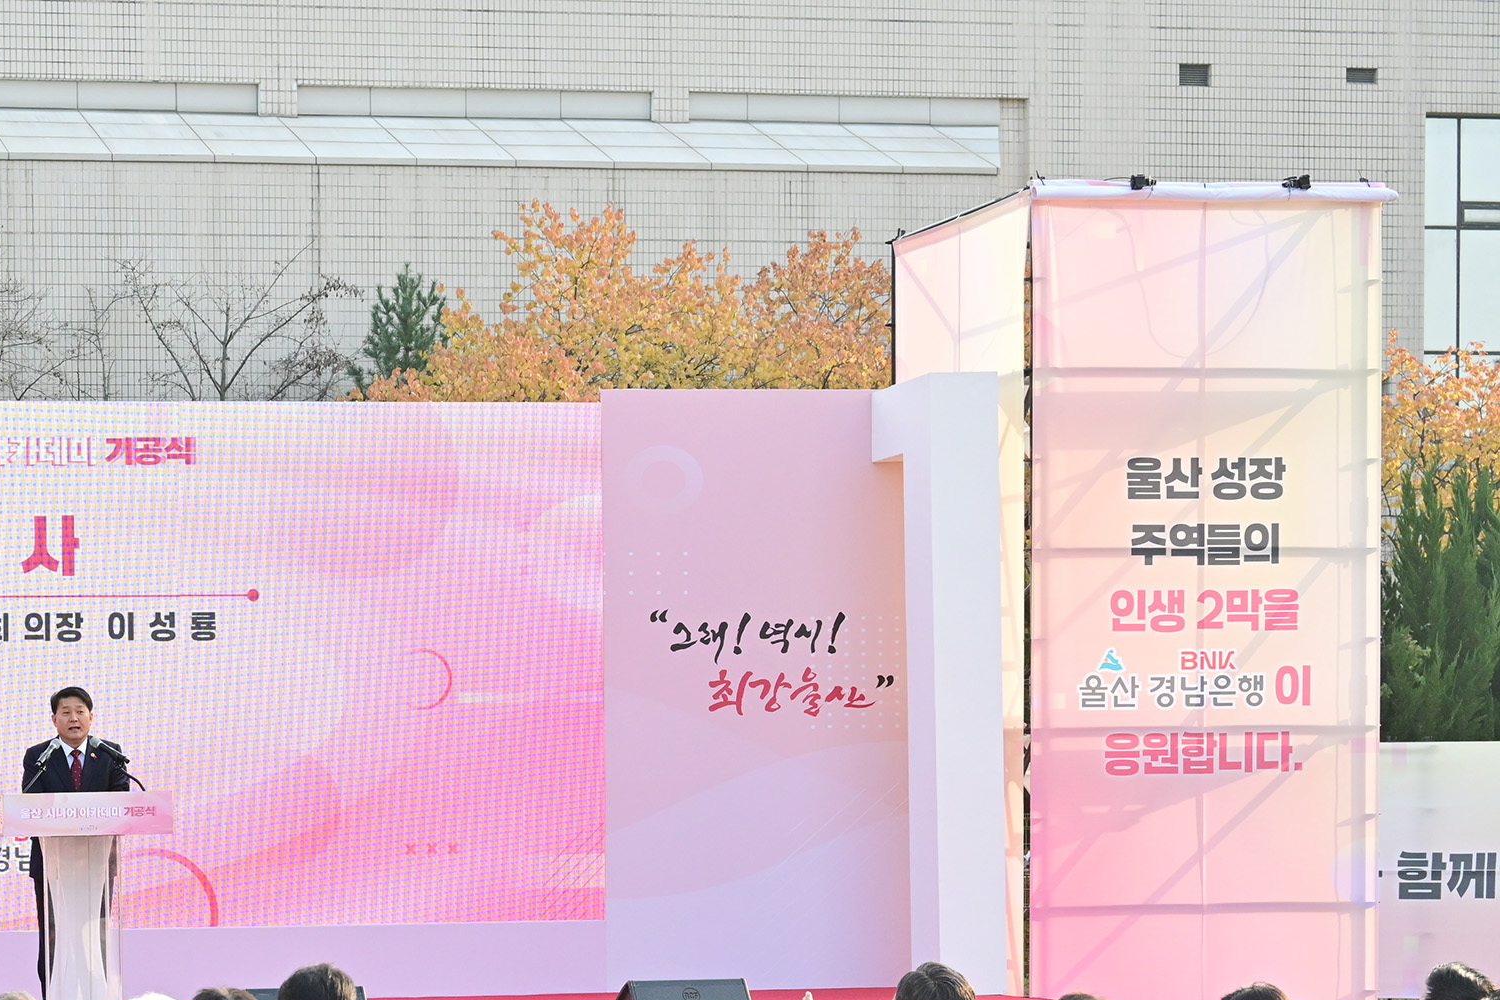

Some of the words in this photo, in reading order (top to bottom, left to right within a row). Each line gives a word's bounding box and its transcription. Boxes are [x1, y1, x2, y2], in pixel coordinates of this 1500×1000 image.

[104, 436, 197, 466] 기공식
[1126, 457, 1202, 500] 울산
[1211, 457, 1286, 500] 성장
[1131, 523, 1280, 565] 주역들의
[24, 612, 84, 643] 의장
[759, 611, 846, 654] 역시!
[1110, 589, 1186, 633] 인생
[1197, 589, 1299, 632] 2막을
[1181, 651, 1236, 670] BNK
[1079, 675, 1140, 708] 울산
[1150, 675, 1265, 708] 경남은행
[1275, 665, 1311, 706] 이
[1105, 732, 1304, 776] 응원합니다.
[20, 808, 43, 820] 울산
[46, 807, 78, 819] 시니어
[79, 806, 121, 818] 아카데미
[124, 806, 156, 817] 기공식
[1397, 851, 1498, 900] 함께
